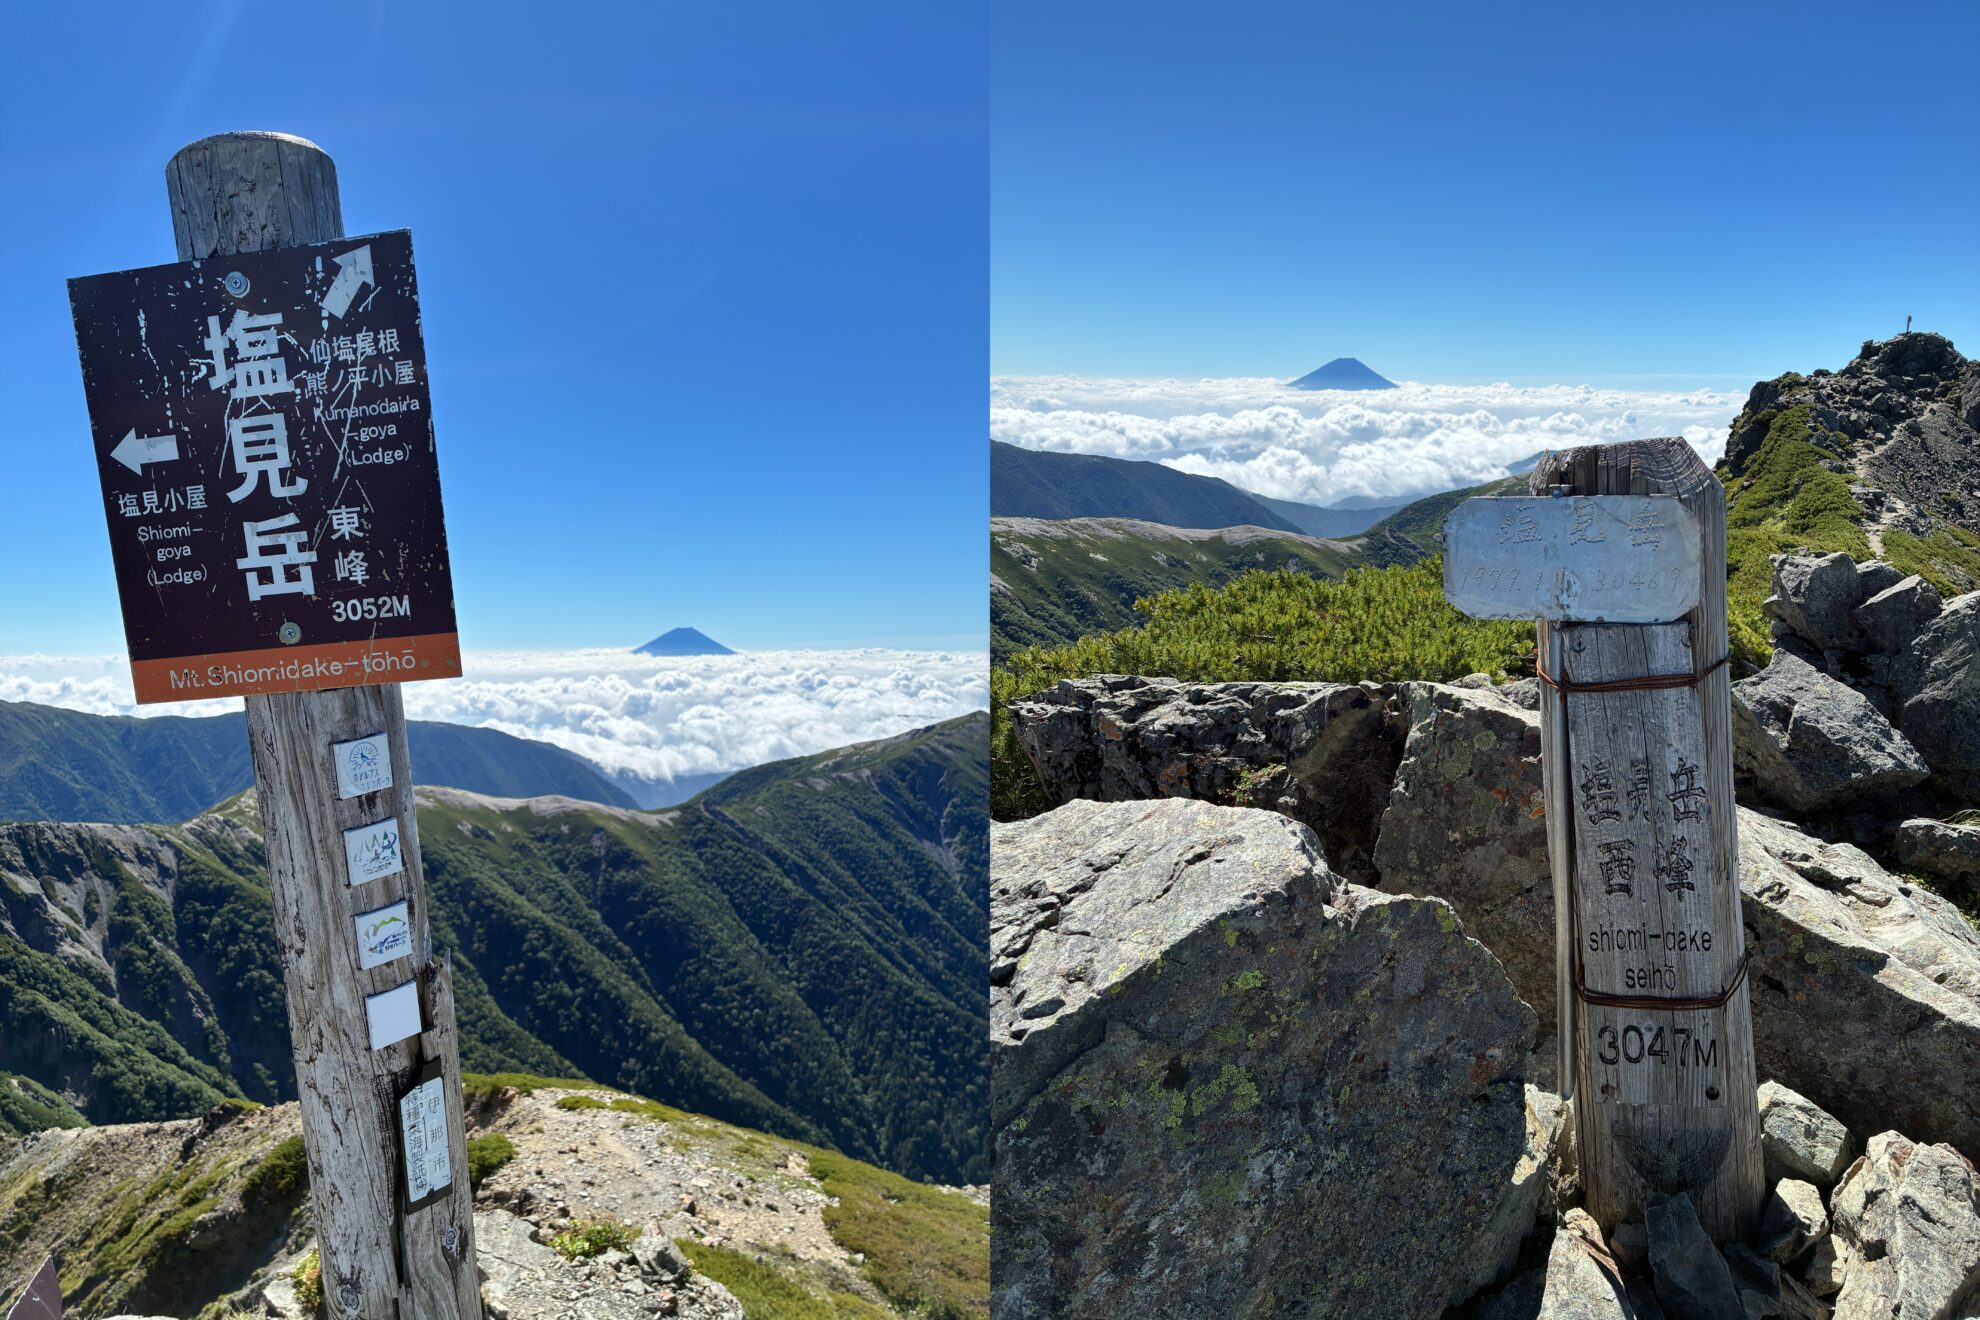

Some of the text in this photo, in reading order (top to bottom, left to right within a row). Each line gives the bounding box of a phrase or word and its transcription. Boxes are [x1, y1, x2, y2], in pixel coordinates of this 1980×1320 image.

[309, 328, 400, 364] 仙塩尾根
[305, 360, 416, 395] 熊ノ平小屋
[203, 309, 317, 602] 塩見岳
[345, 443, 410, 467] (Lodge)
[118, 484, 208, 517] 塩見小屋
[157, 545, 192, 561] goya
[327, 505, 370, 586] 東峰
[147, 563, 207, 587] (Lodge)
[331, 594, 411, 622] 3052M
[1597, 1025, 1719, 1068] 3047M
